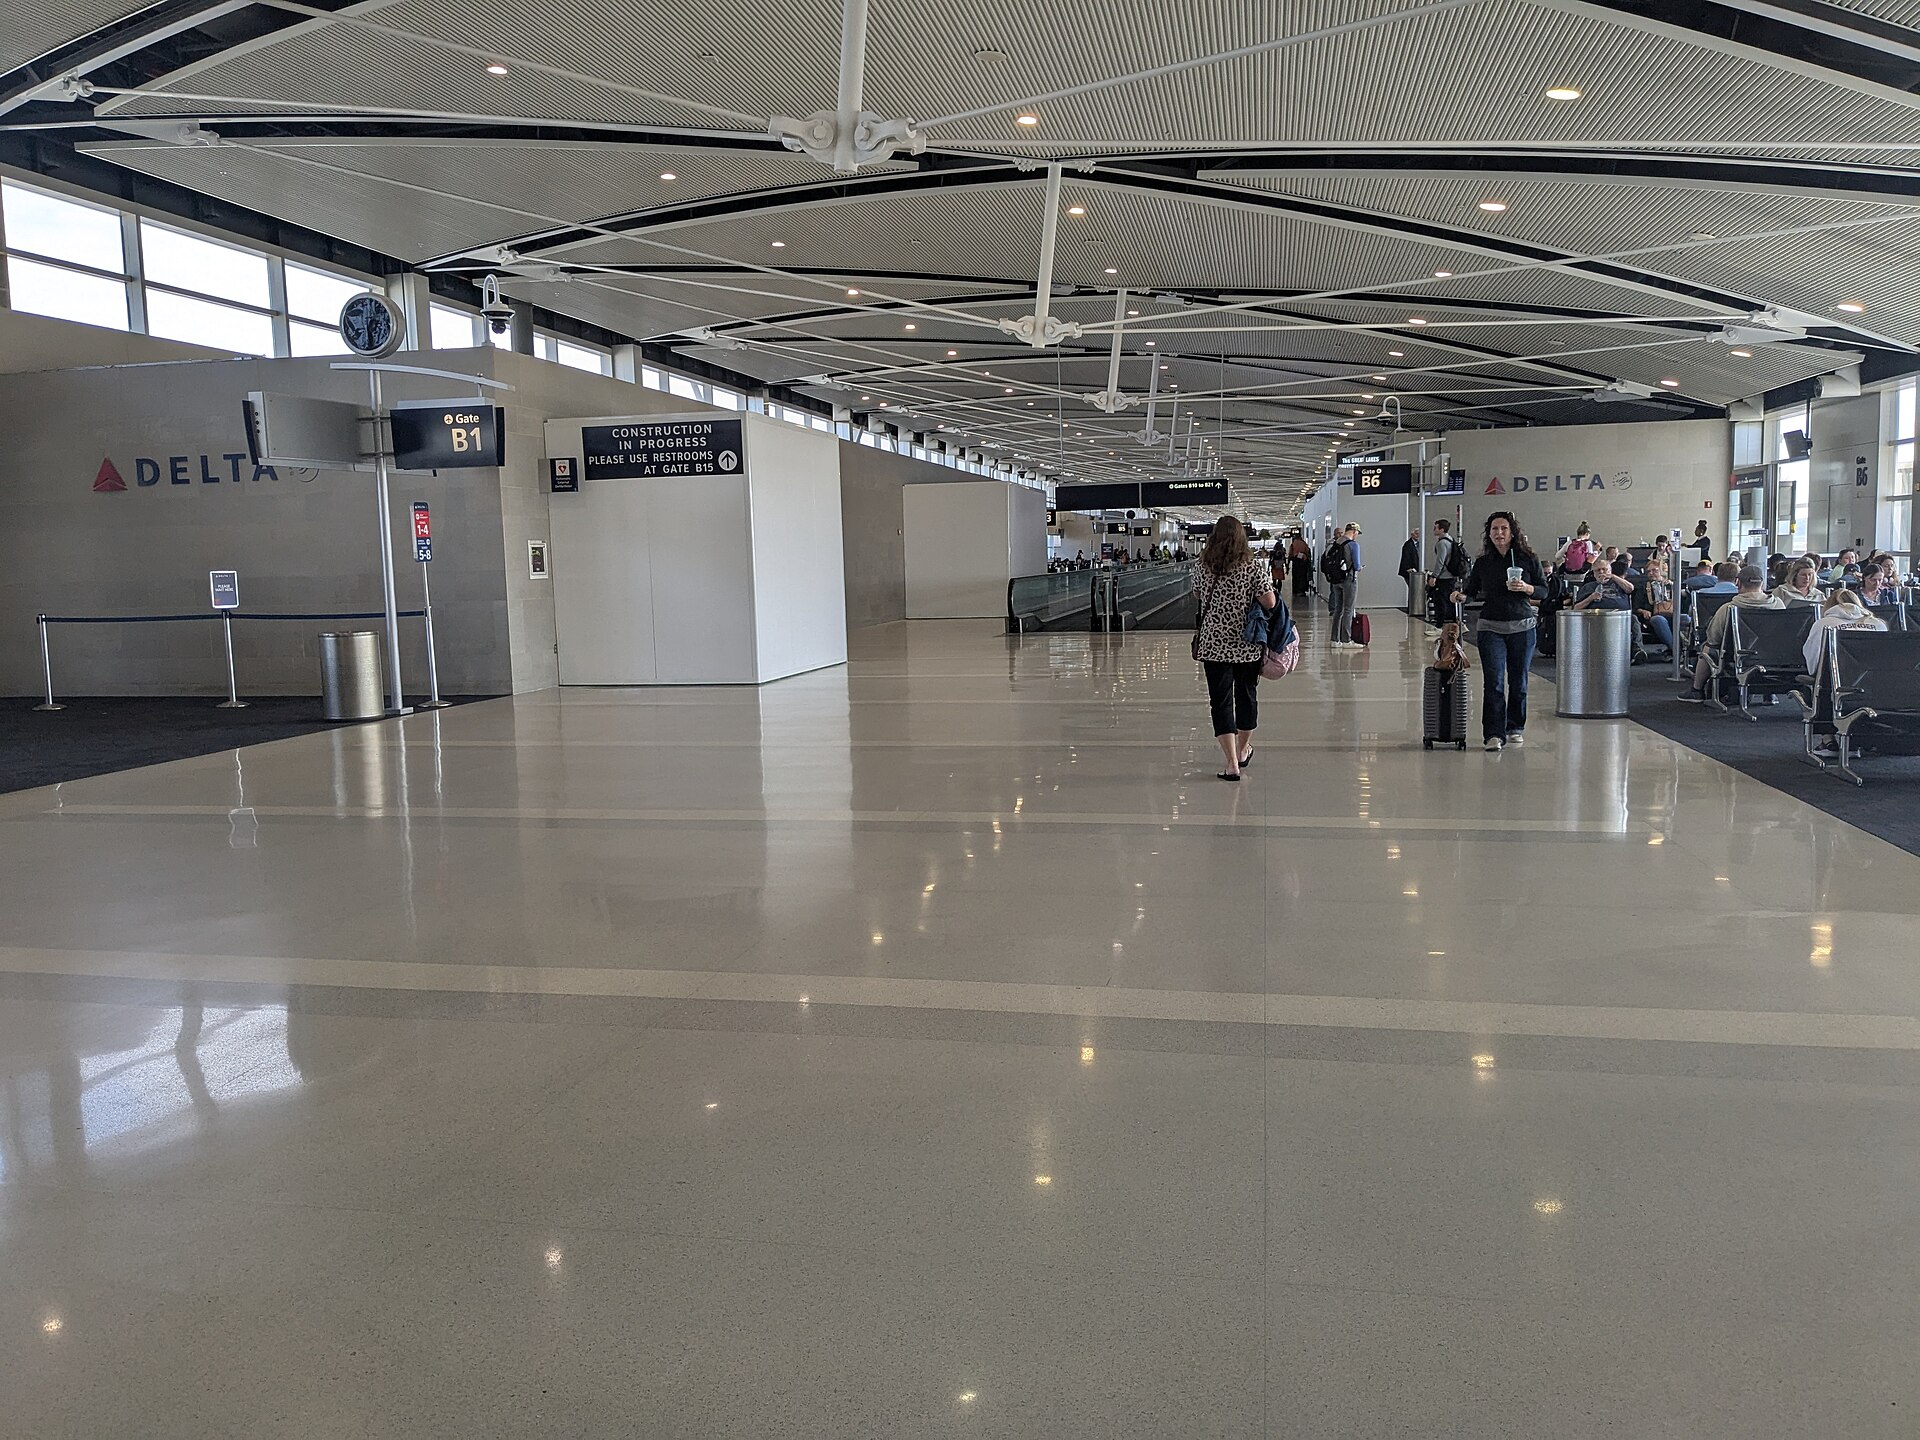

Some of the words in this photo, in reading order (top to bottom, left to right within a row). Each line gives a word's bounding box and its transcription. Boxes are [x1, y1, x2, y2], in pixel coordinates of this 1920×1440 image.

[455, 414, 480, 424] Gate
[612, 424, 712, 438] CONSTRUCTION
[451, 427, 482, 452] B1
[619, 440, 632, 450] IN
[640, 437, 707, 449] PROGRESS
[588, 454, 625, 465] PLEASE
[630, 453, 648, 463] USE
[653, 451, 714, 462] RESTROOMS
[135, 453, 279, 487] DELTA
[644, 465, 657, 475] AT
[662, 464, 690, 474] GATE
[695, 463, 714, 473] B15
[1361, 475, 1380, 488] B6
[1513, 474, 1605, 492] DELTA
[1856, 466, 1868, 487] B6
[417, 524, 429, 536] 1-4
[419, 549, 432, 561] 5-8
